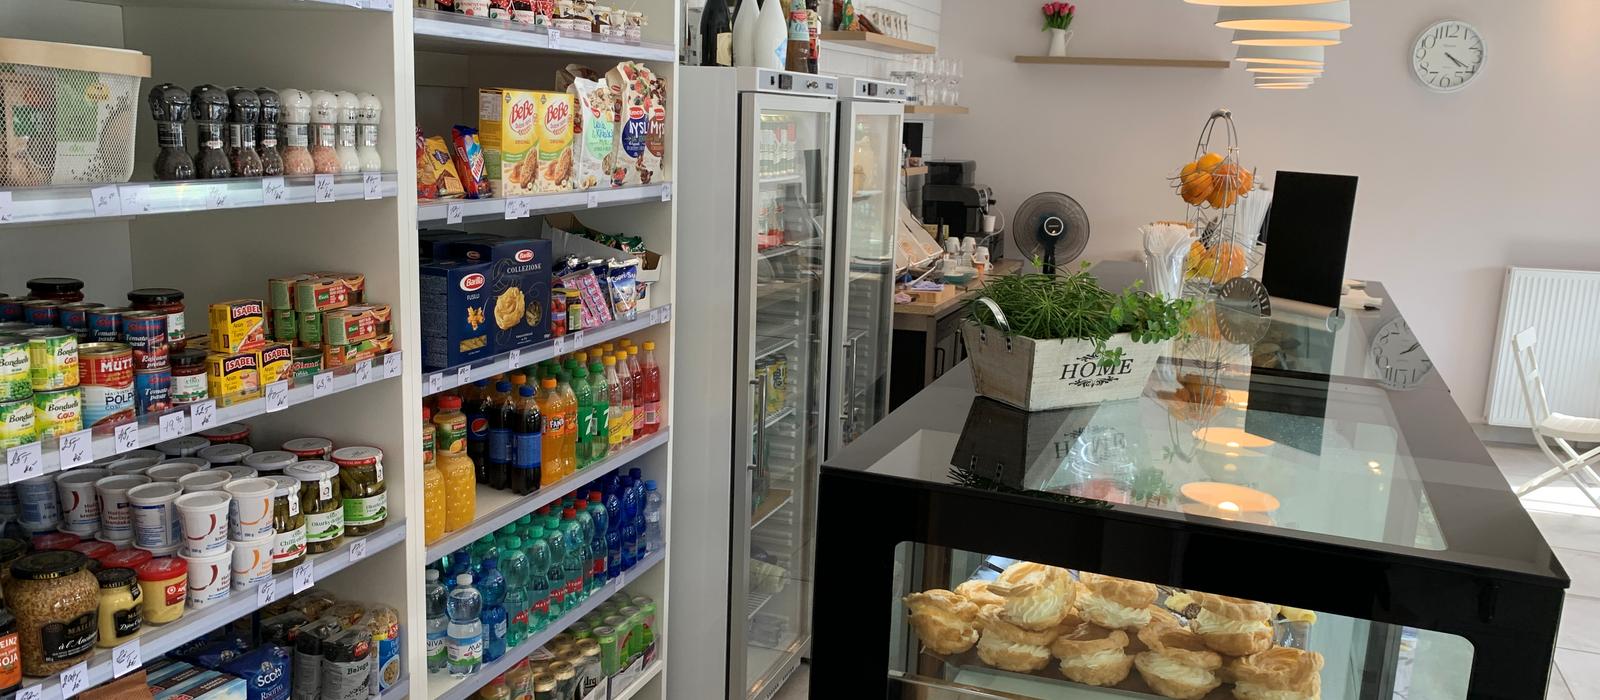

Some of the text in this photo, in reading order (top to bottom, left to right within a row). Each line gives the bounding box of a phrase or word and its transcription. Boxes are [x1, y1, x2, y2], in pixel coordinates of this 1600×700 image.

[507, 263, 542, 274] COLLEZIONE
[232, 305, 261, 318] ISABEL
[264, 349, 289, 362] ISABEL
[226, 357, 256, 371] ISABEL
[1059, 358, 1134, 381] HOME
[0, 636, 17, 647] EINZ
